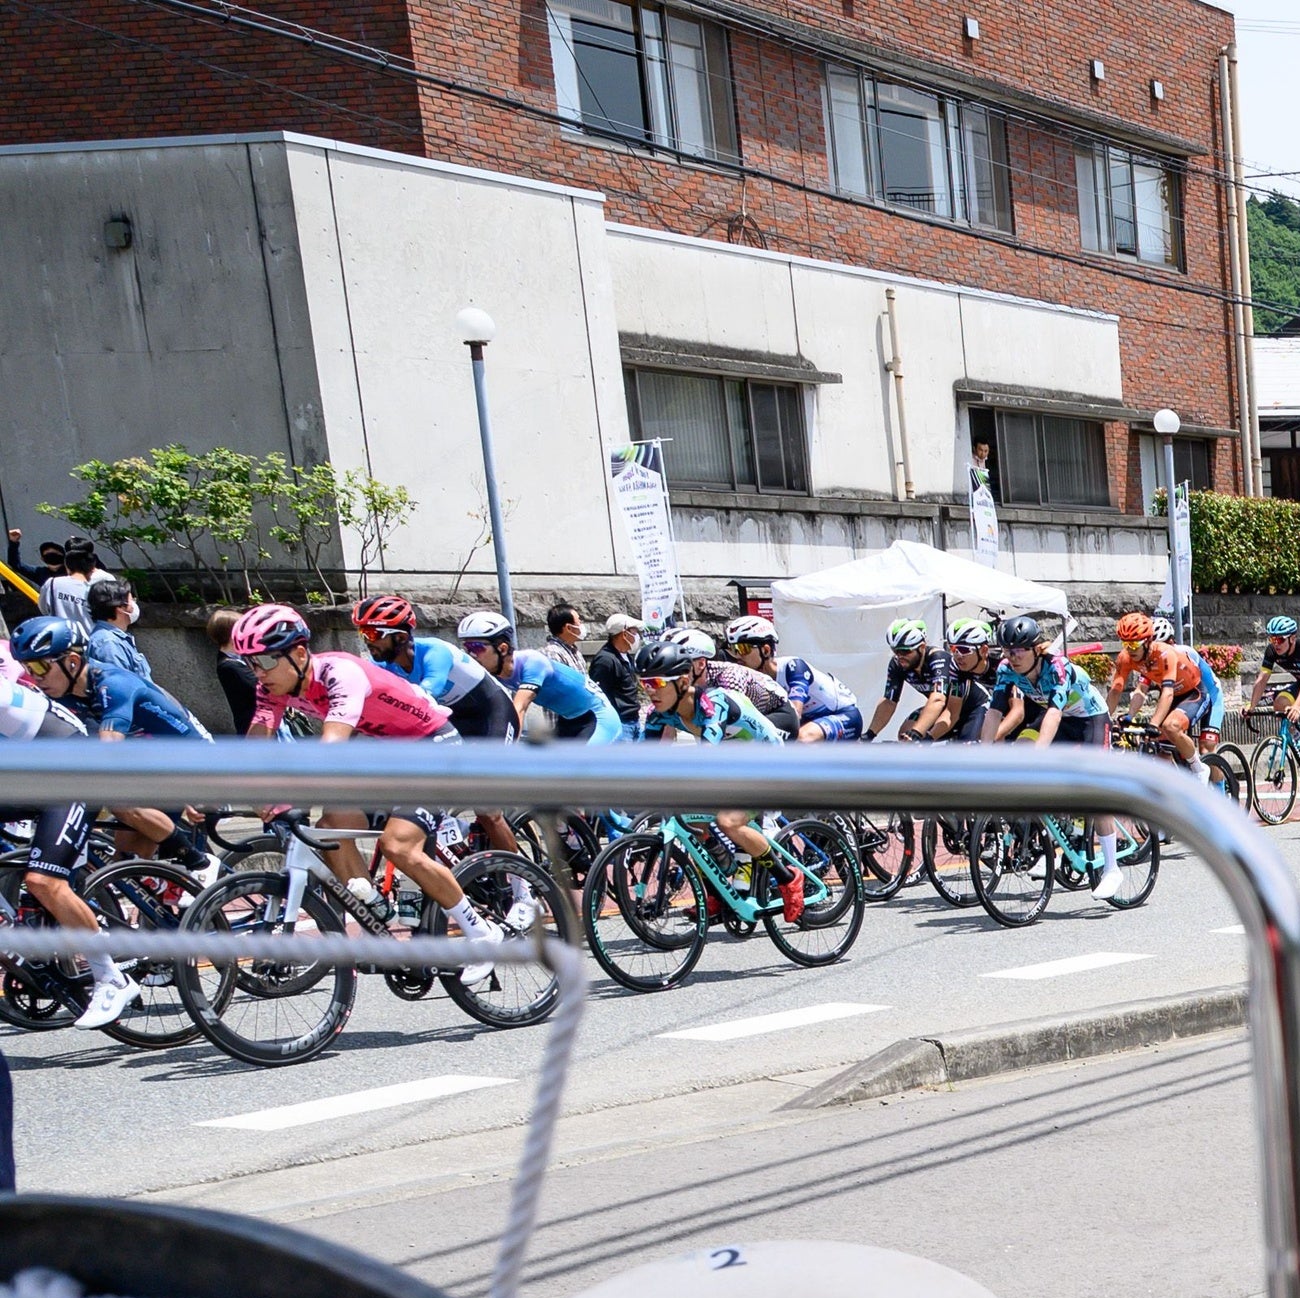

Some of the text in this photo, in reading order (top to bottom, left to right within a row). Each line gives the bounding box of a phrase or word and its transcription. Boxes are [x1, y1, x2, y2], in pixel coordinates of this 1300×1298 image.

[377, 692, 432, 724] cannondale
[441, 828, 458, 844] 73
[687, 834, 742, 901] Bianchi
[710, 1248, 748, 1271] 2
